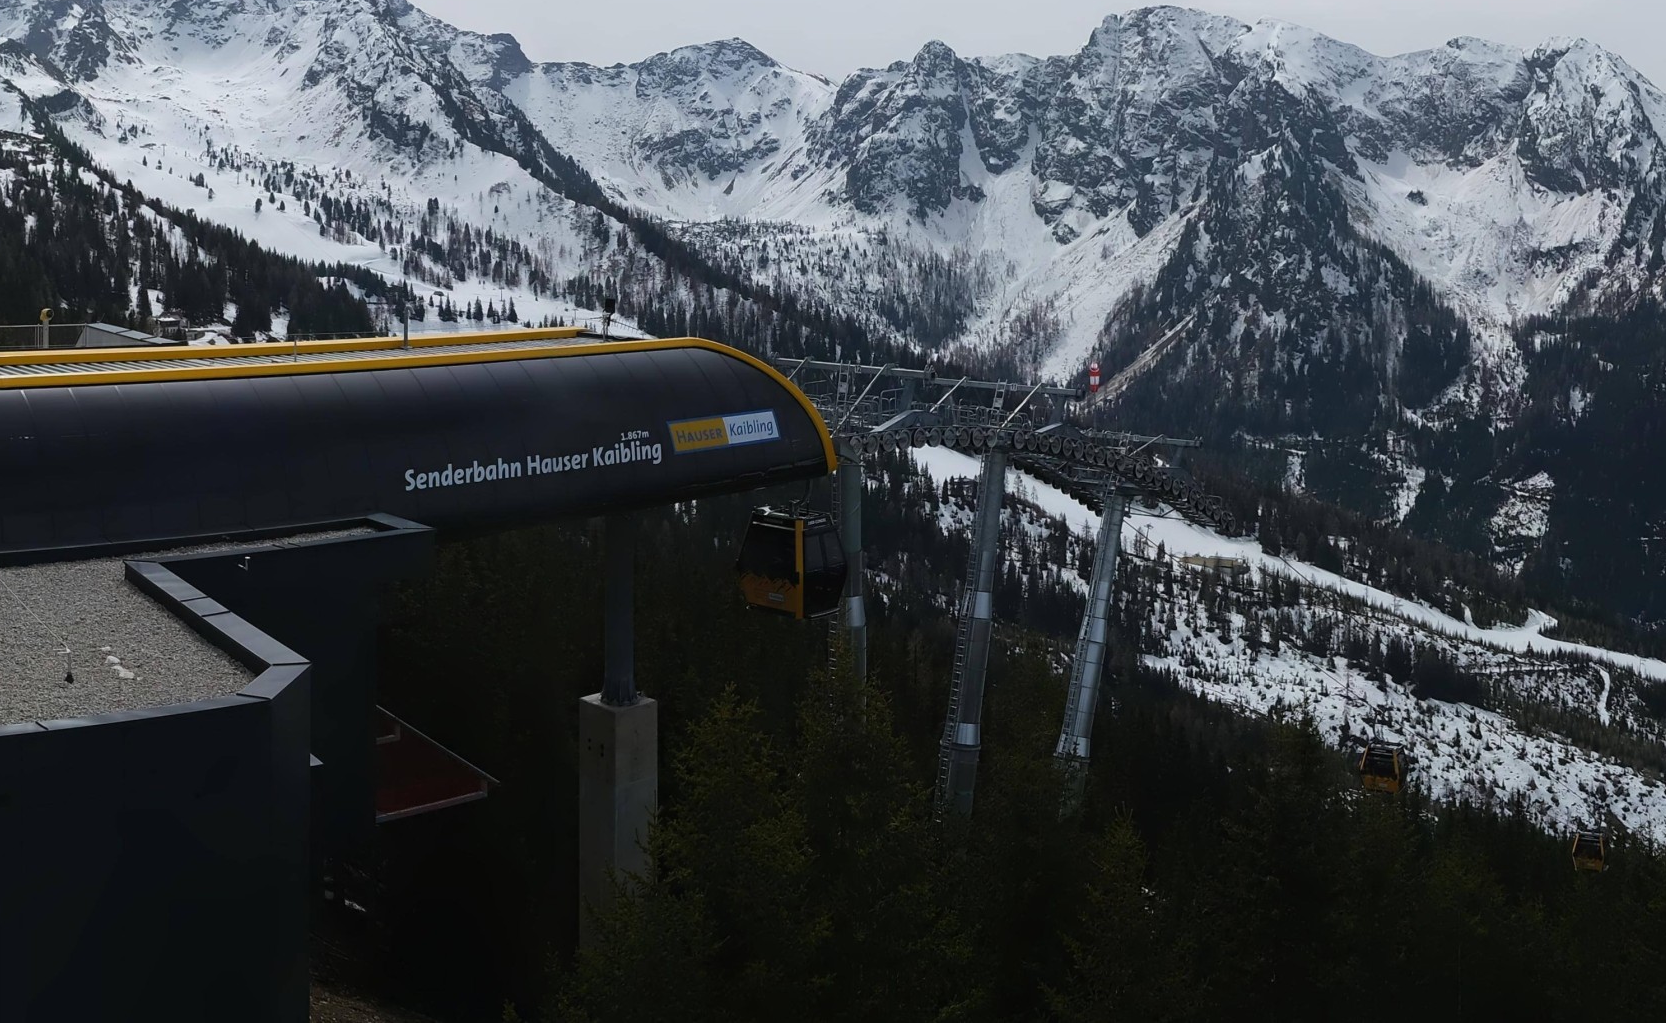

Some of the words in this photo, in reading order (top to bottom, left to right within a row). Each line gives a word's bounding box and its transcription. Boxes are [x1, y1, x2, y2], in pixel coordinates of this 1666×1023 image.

[620, 429, 649, 441] 1.867m
[676, 426, 723, 444] HAUSER
[729, 418, 774, 440] Kaibling
[404, 457, 522, 492] Senderbahn
[526, 448, 589, 475] Hauser
[592, 440, 663, 468] Kaibling
